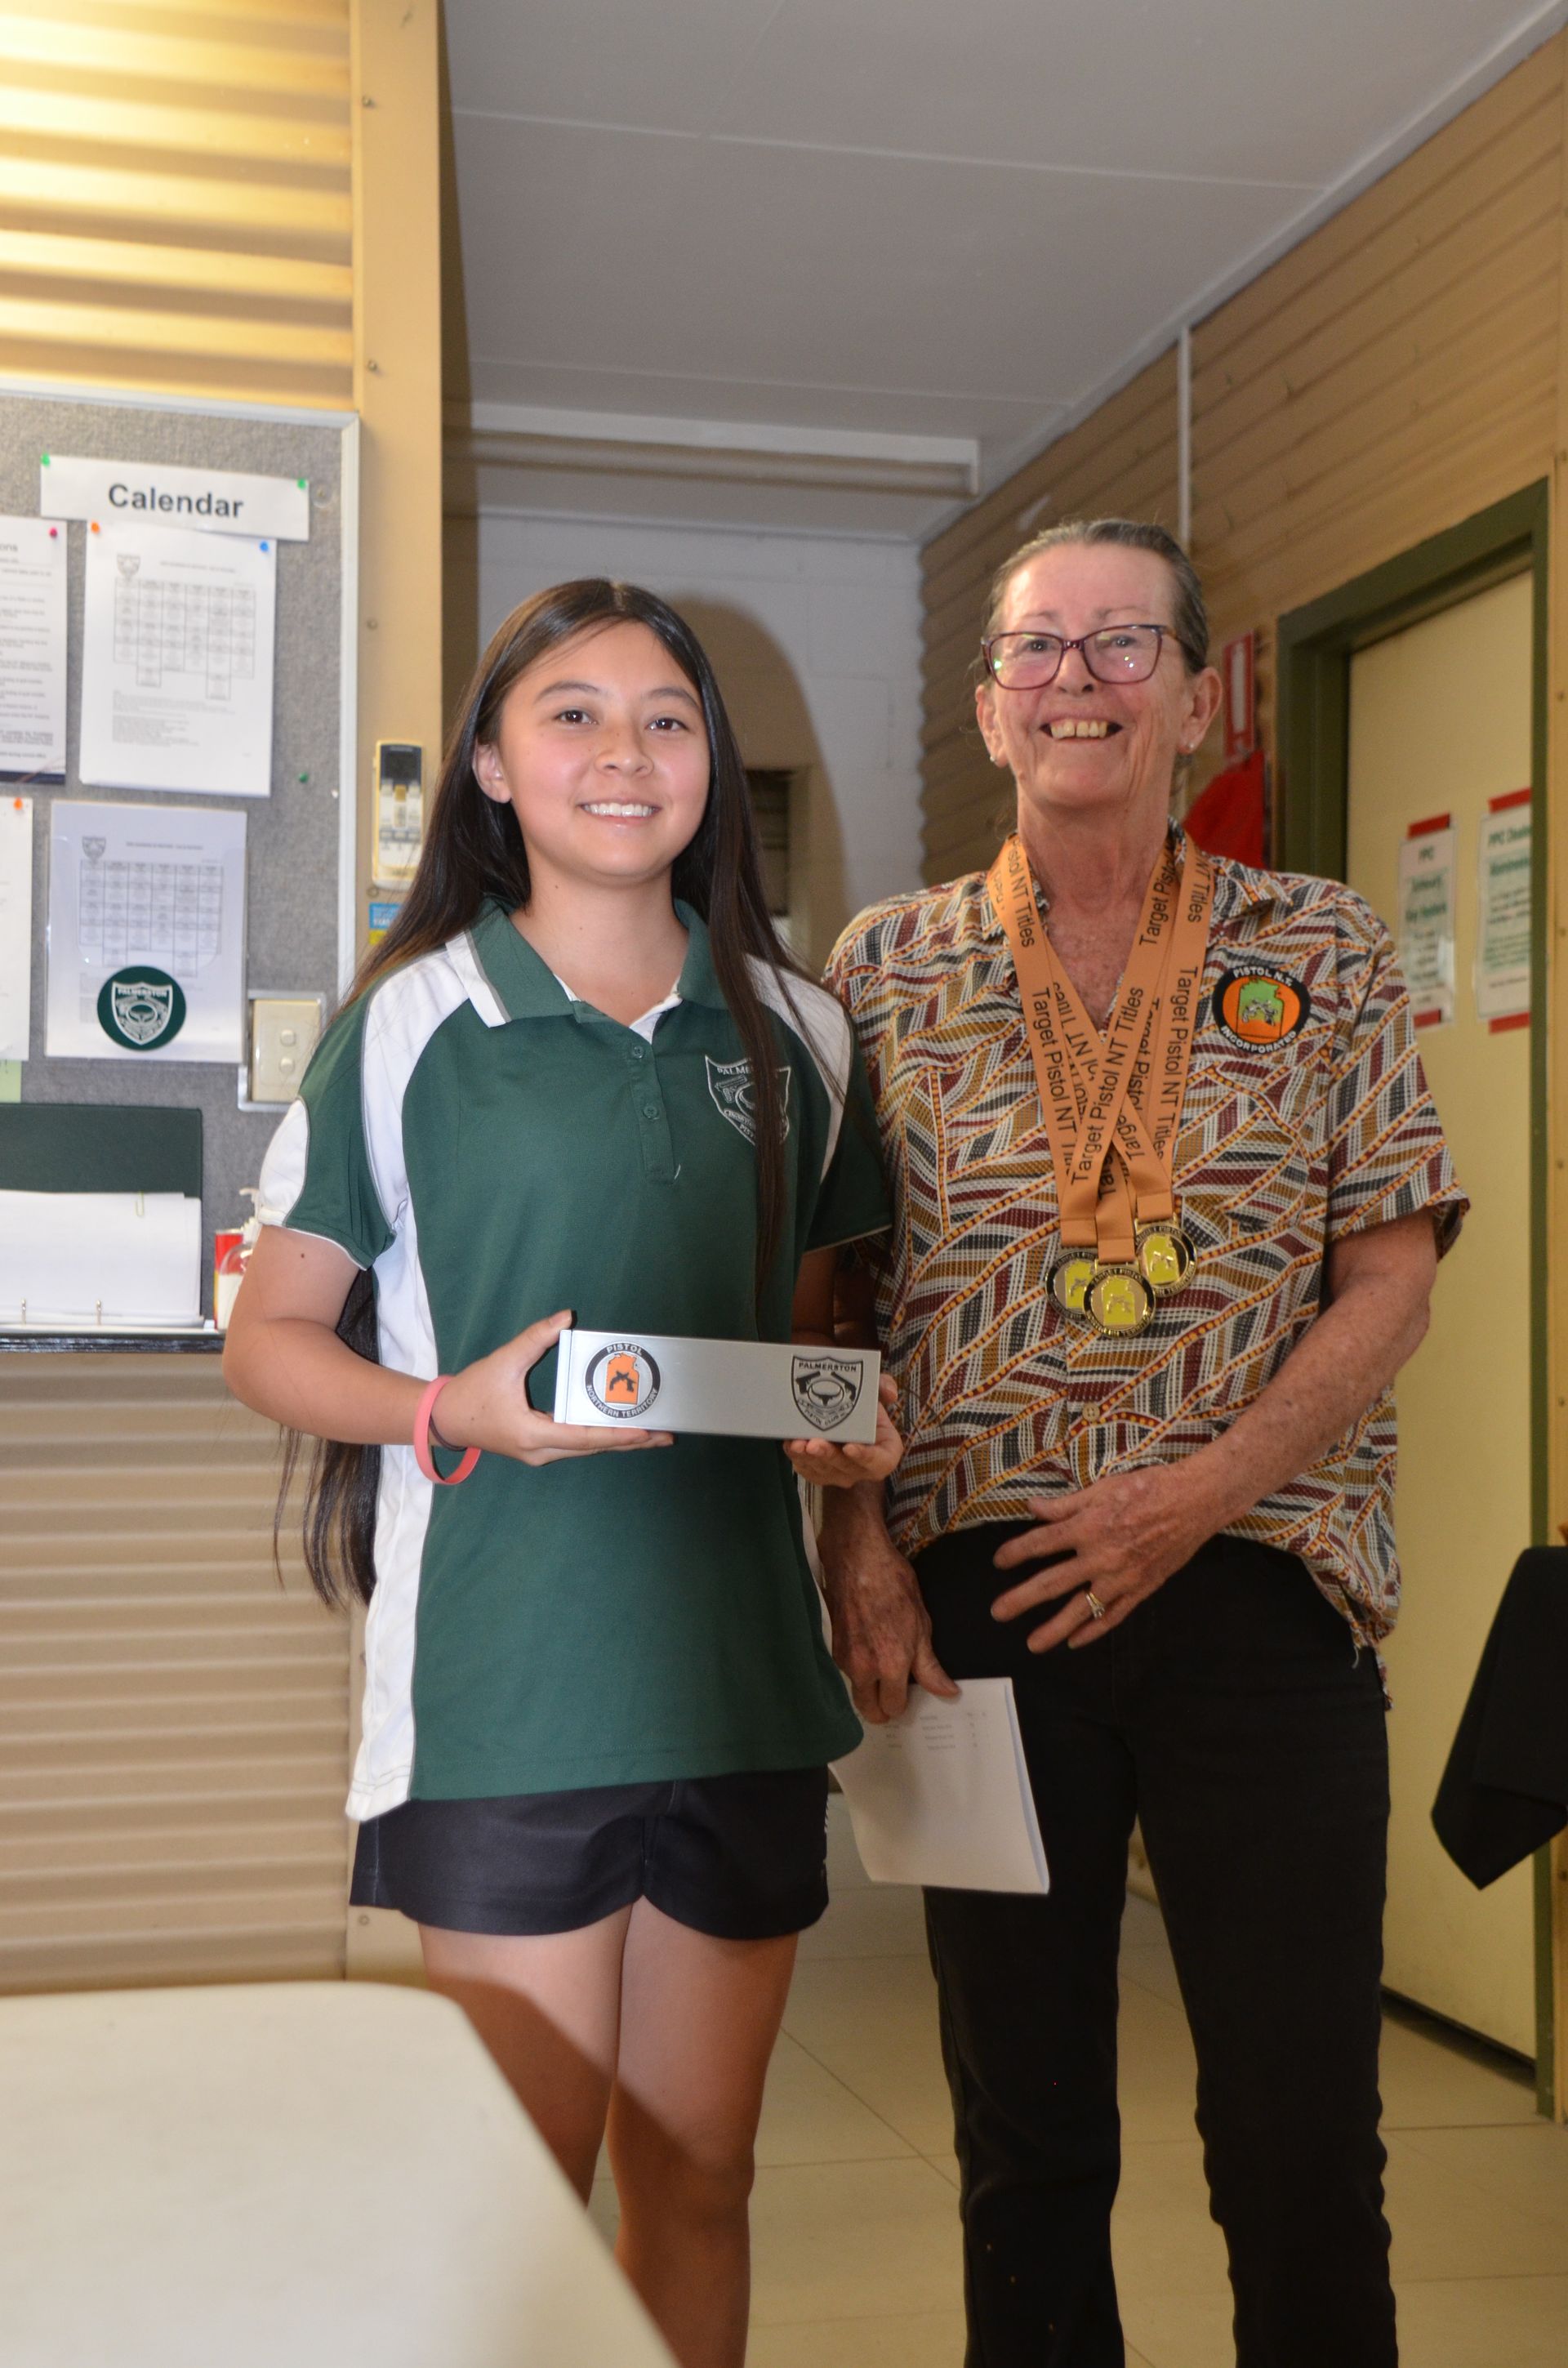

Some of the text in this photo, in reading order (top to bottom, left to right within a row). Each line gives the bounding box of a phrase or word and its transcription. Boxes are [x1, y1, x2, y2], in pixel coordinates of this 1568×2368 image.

[108, 483, 244, 519] Calendar
[1011, 876, 1029, 899] NT
[1187, 883, 1211, 923] Titles
[1015, 901, 1036, 948] Titles
[1138, 898, 1169, 946] Target
[1233, 966, 1272, 979] PISTOL
[1031, 987, 1058, 1049] Target
[1114, 986, 1144, 1034] Titles
[1065, 1032, 1094, 1057] NT
[1104, 1037, 1129, 1066] NT
[1221, 1025, 1297, 1054] INCORPORATED
[1045, 1050, 1071, 1102] Pistol
[1153, 966, 1199, 1161] Target Pistol NT Titles
[1089, 1069, 1121, 1121] Pistol
[1054, 1106, 1077, 1134] NT
[1117, 1113, 1146, 1161] Targe
[1071, 1125, 1103, 1186] Target
[606, 1344, 643, 1356] PISTOL
[799, 1362, 857, 1372] PALMERSTON
[586, 1384, 658, 1417] NORTHERN TERRITORY
